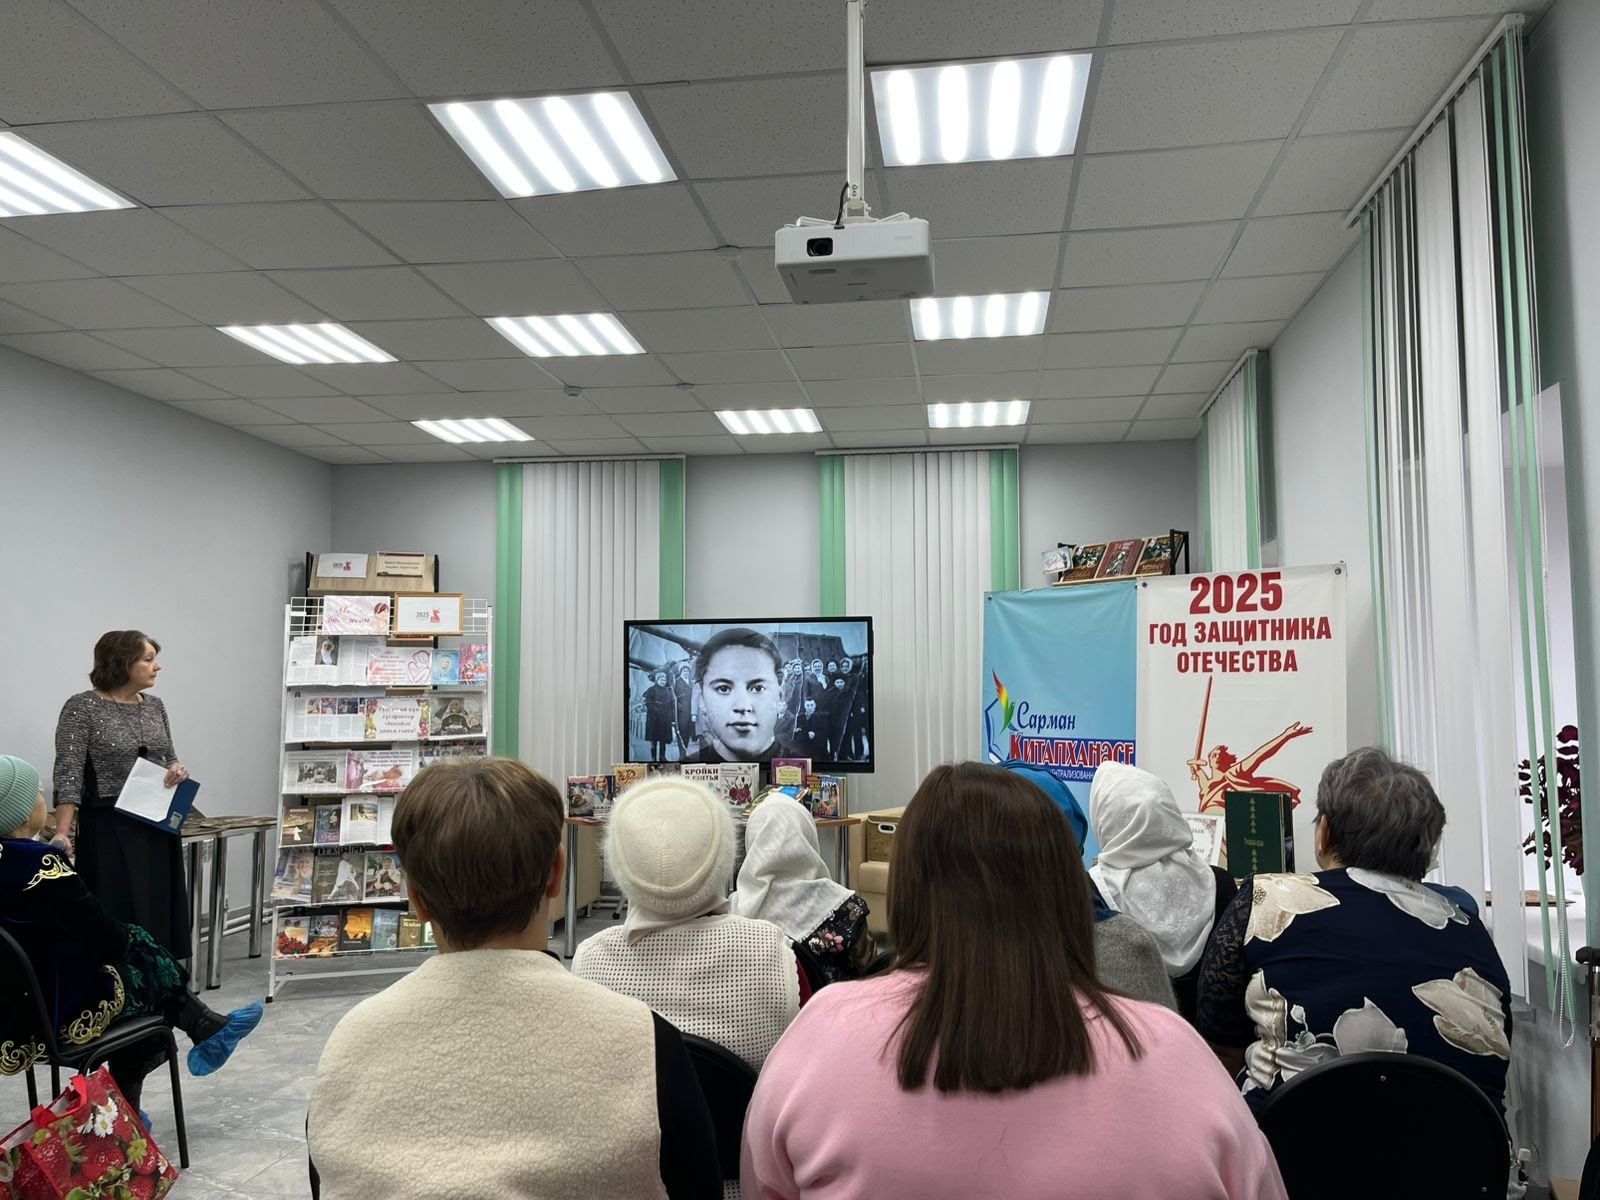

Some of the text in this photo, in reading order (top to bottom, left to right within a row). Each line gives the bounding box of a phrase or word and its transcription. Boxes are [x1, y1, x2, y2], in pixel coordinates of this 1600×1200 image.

[1189, 571, 1283, 614] 2025
[1149, 616, 1332, 648] ГОД ЗАЩИТНИКА
[1177, 649, 1298, 674] ОТЕЧЕСТВА
[1017, 701, 1076, 734] Сарман
